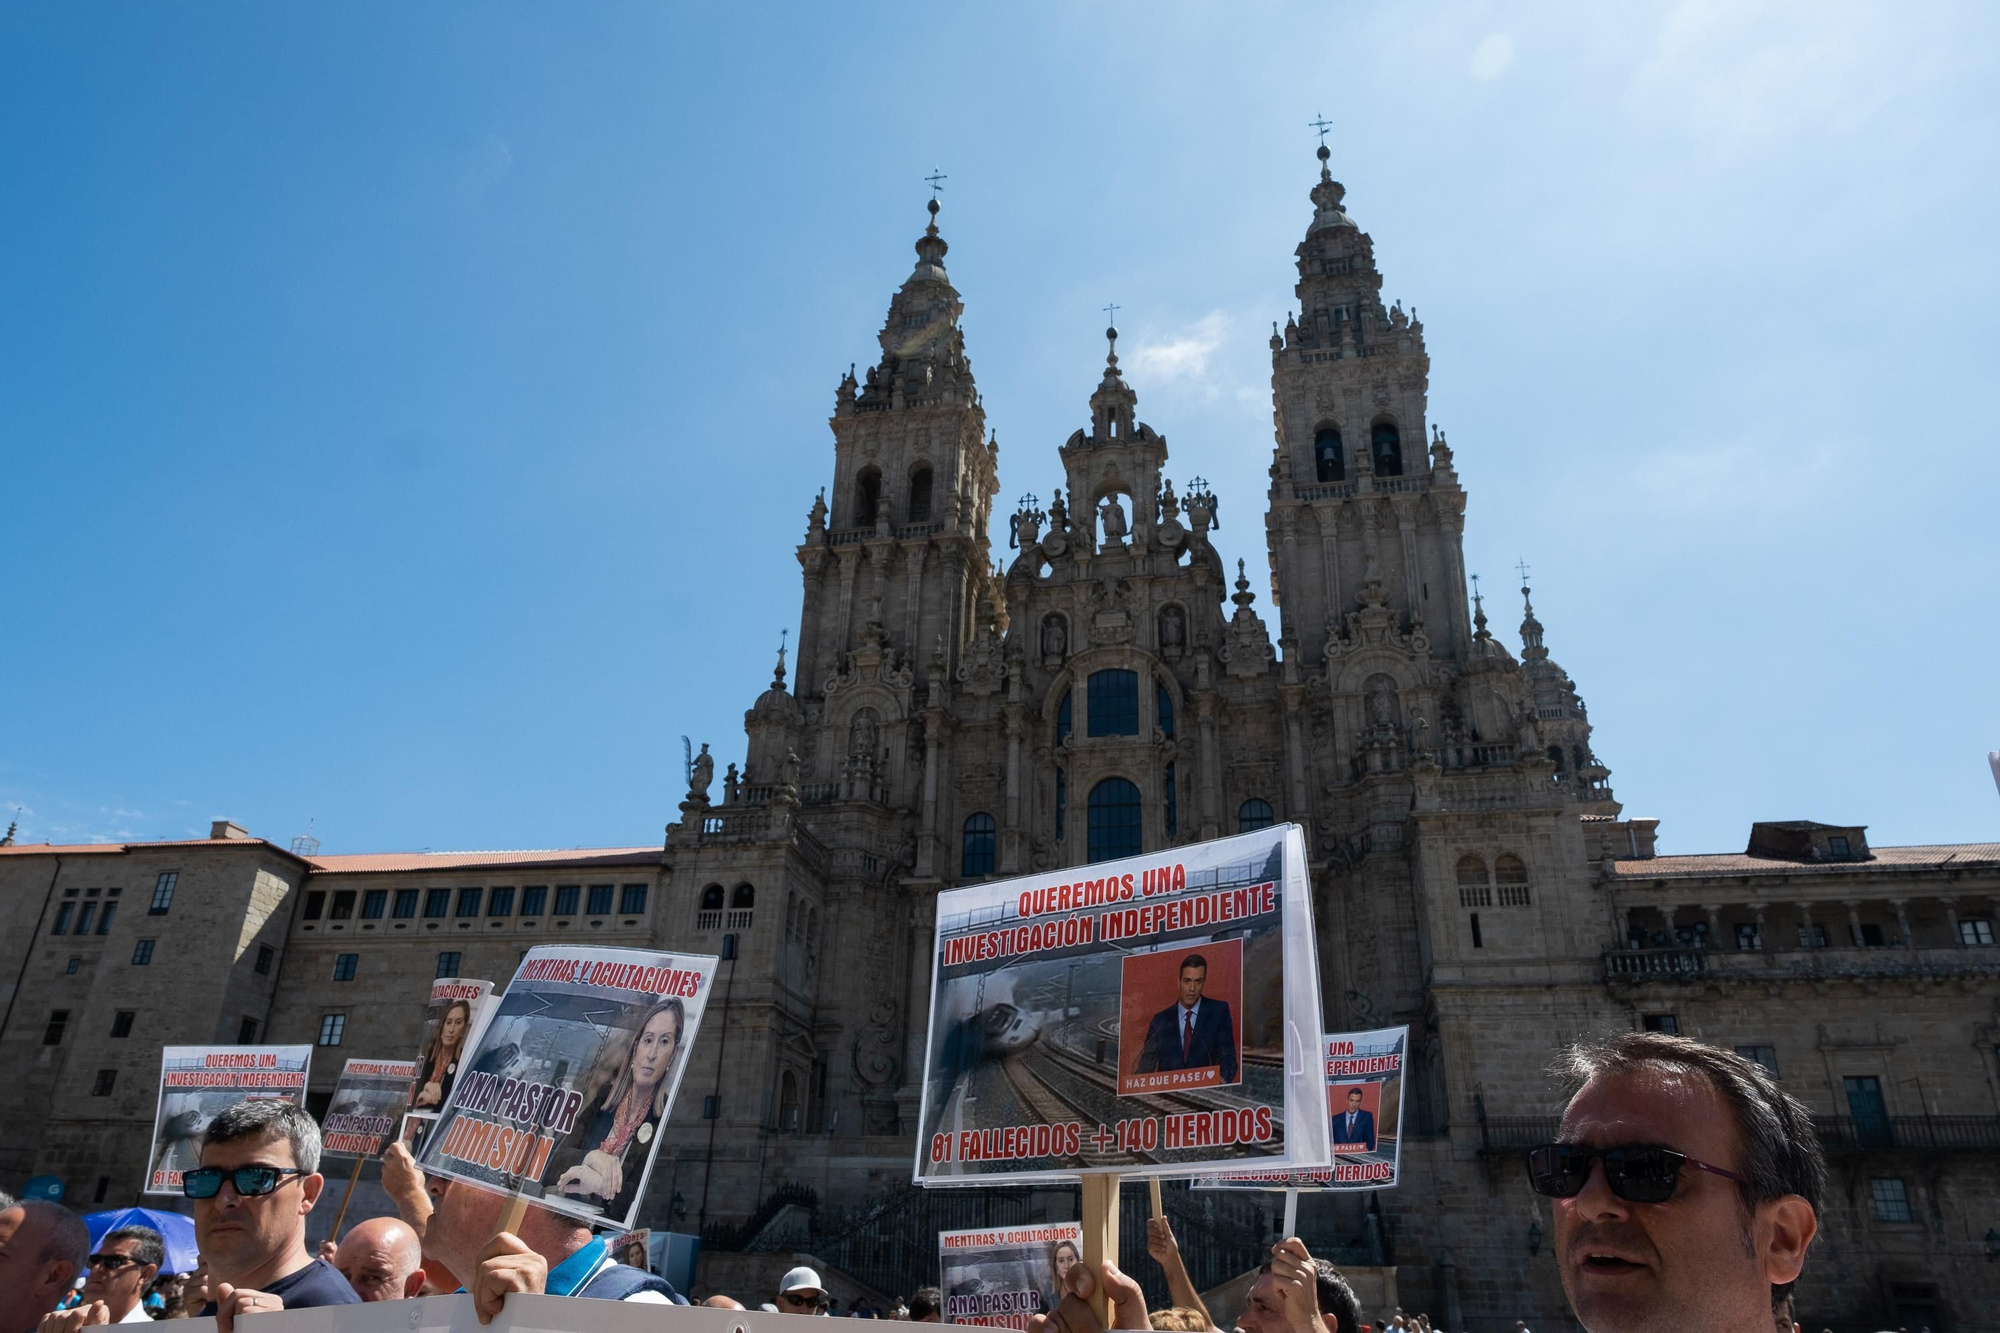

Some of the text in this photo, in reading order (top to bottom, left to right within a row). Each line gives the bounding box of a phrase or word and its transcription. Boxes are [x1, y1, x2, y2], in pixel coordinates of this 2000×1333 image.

[1018, 863, 1186, 918] QUEREMOS UNA
[943, 881, 1275, 966] INVESTIGACIÓN INDEPENDIENTE
[520, 958, 701, 998] MENTIRAS Y OCULTACIONES
[1329, 1041, 1354, 1056] UNA
[205, 1054, 277, 1068] QUEREMOS UNA
[347, 1063, 382, 1075] MENTIRAS
[383, 1065, 389, 1076] Y
[389, 1065, 416, 1077] OCULTA
[1326, 1055, 1399, 1076] EPENDIENTE
[165, 1070, 305, 1088] INVESTIGACIÓN INDEPENDIENTE
[1126, 1078, 1146, 1088] HAZ
[1149, 1075, 1169, 1086] QUE
[454, 1070, 498, 1113] ANA
[493, 1077, 583, 1135] PASTOR
[325, 1113, 393, 1135] ANA PASTOR
[931, 1132, 952, 1163] 81
[958, 1122, 1080, 1162] FALLECIDOS
[1164, 1105, 1273, 1149] HERIDOS
[440, 1115, 555, 1182] DIMISIÓN
[154, 1170, 165, 1186] 81
[1335, 1162, 1390, 1182] HERIDOS
[944, 1227, 1078, 1248] MENTIRAS Y OCULTACIONES
[948, 1290, 1040, 1315] ANA PASTOR
